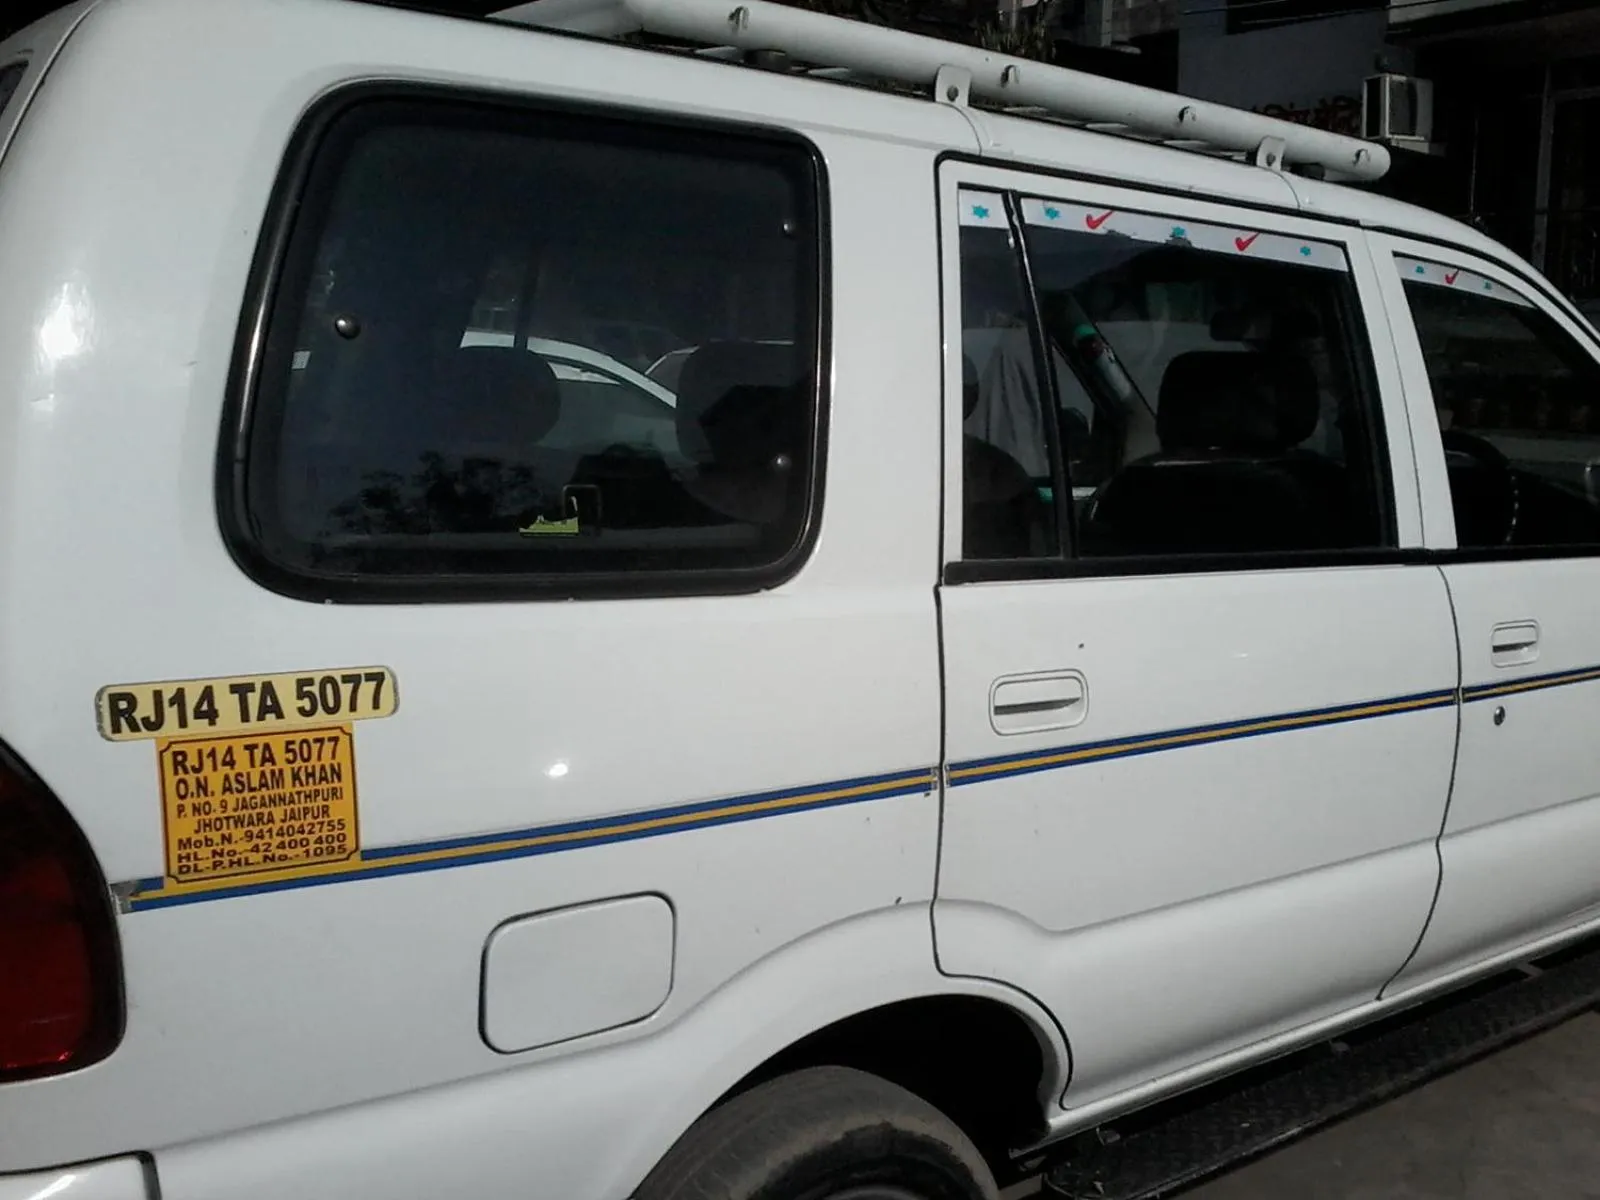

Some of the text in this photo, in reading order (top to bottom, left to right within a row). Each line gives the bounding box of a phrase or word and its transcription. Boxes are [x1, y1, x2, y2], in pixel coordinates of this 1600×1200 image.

[108, 672, 385, 734] RJ14 TA 5077
[172, 736, 339, 776] RJ14 TA 5077
[176, 763, 341, 800] O.N. ASLAM KHAN
[177, 804, 187, 818] P.
[220, 800, 227, 812] 9
[233, 787, 343, 812] JAGANNATHPURI
[194, 805, 330, 834] JHOTWARA JAIPUR
[276, 838, 309, 850] 400
[313, 833, 346, 844] 400
